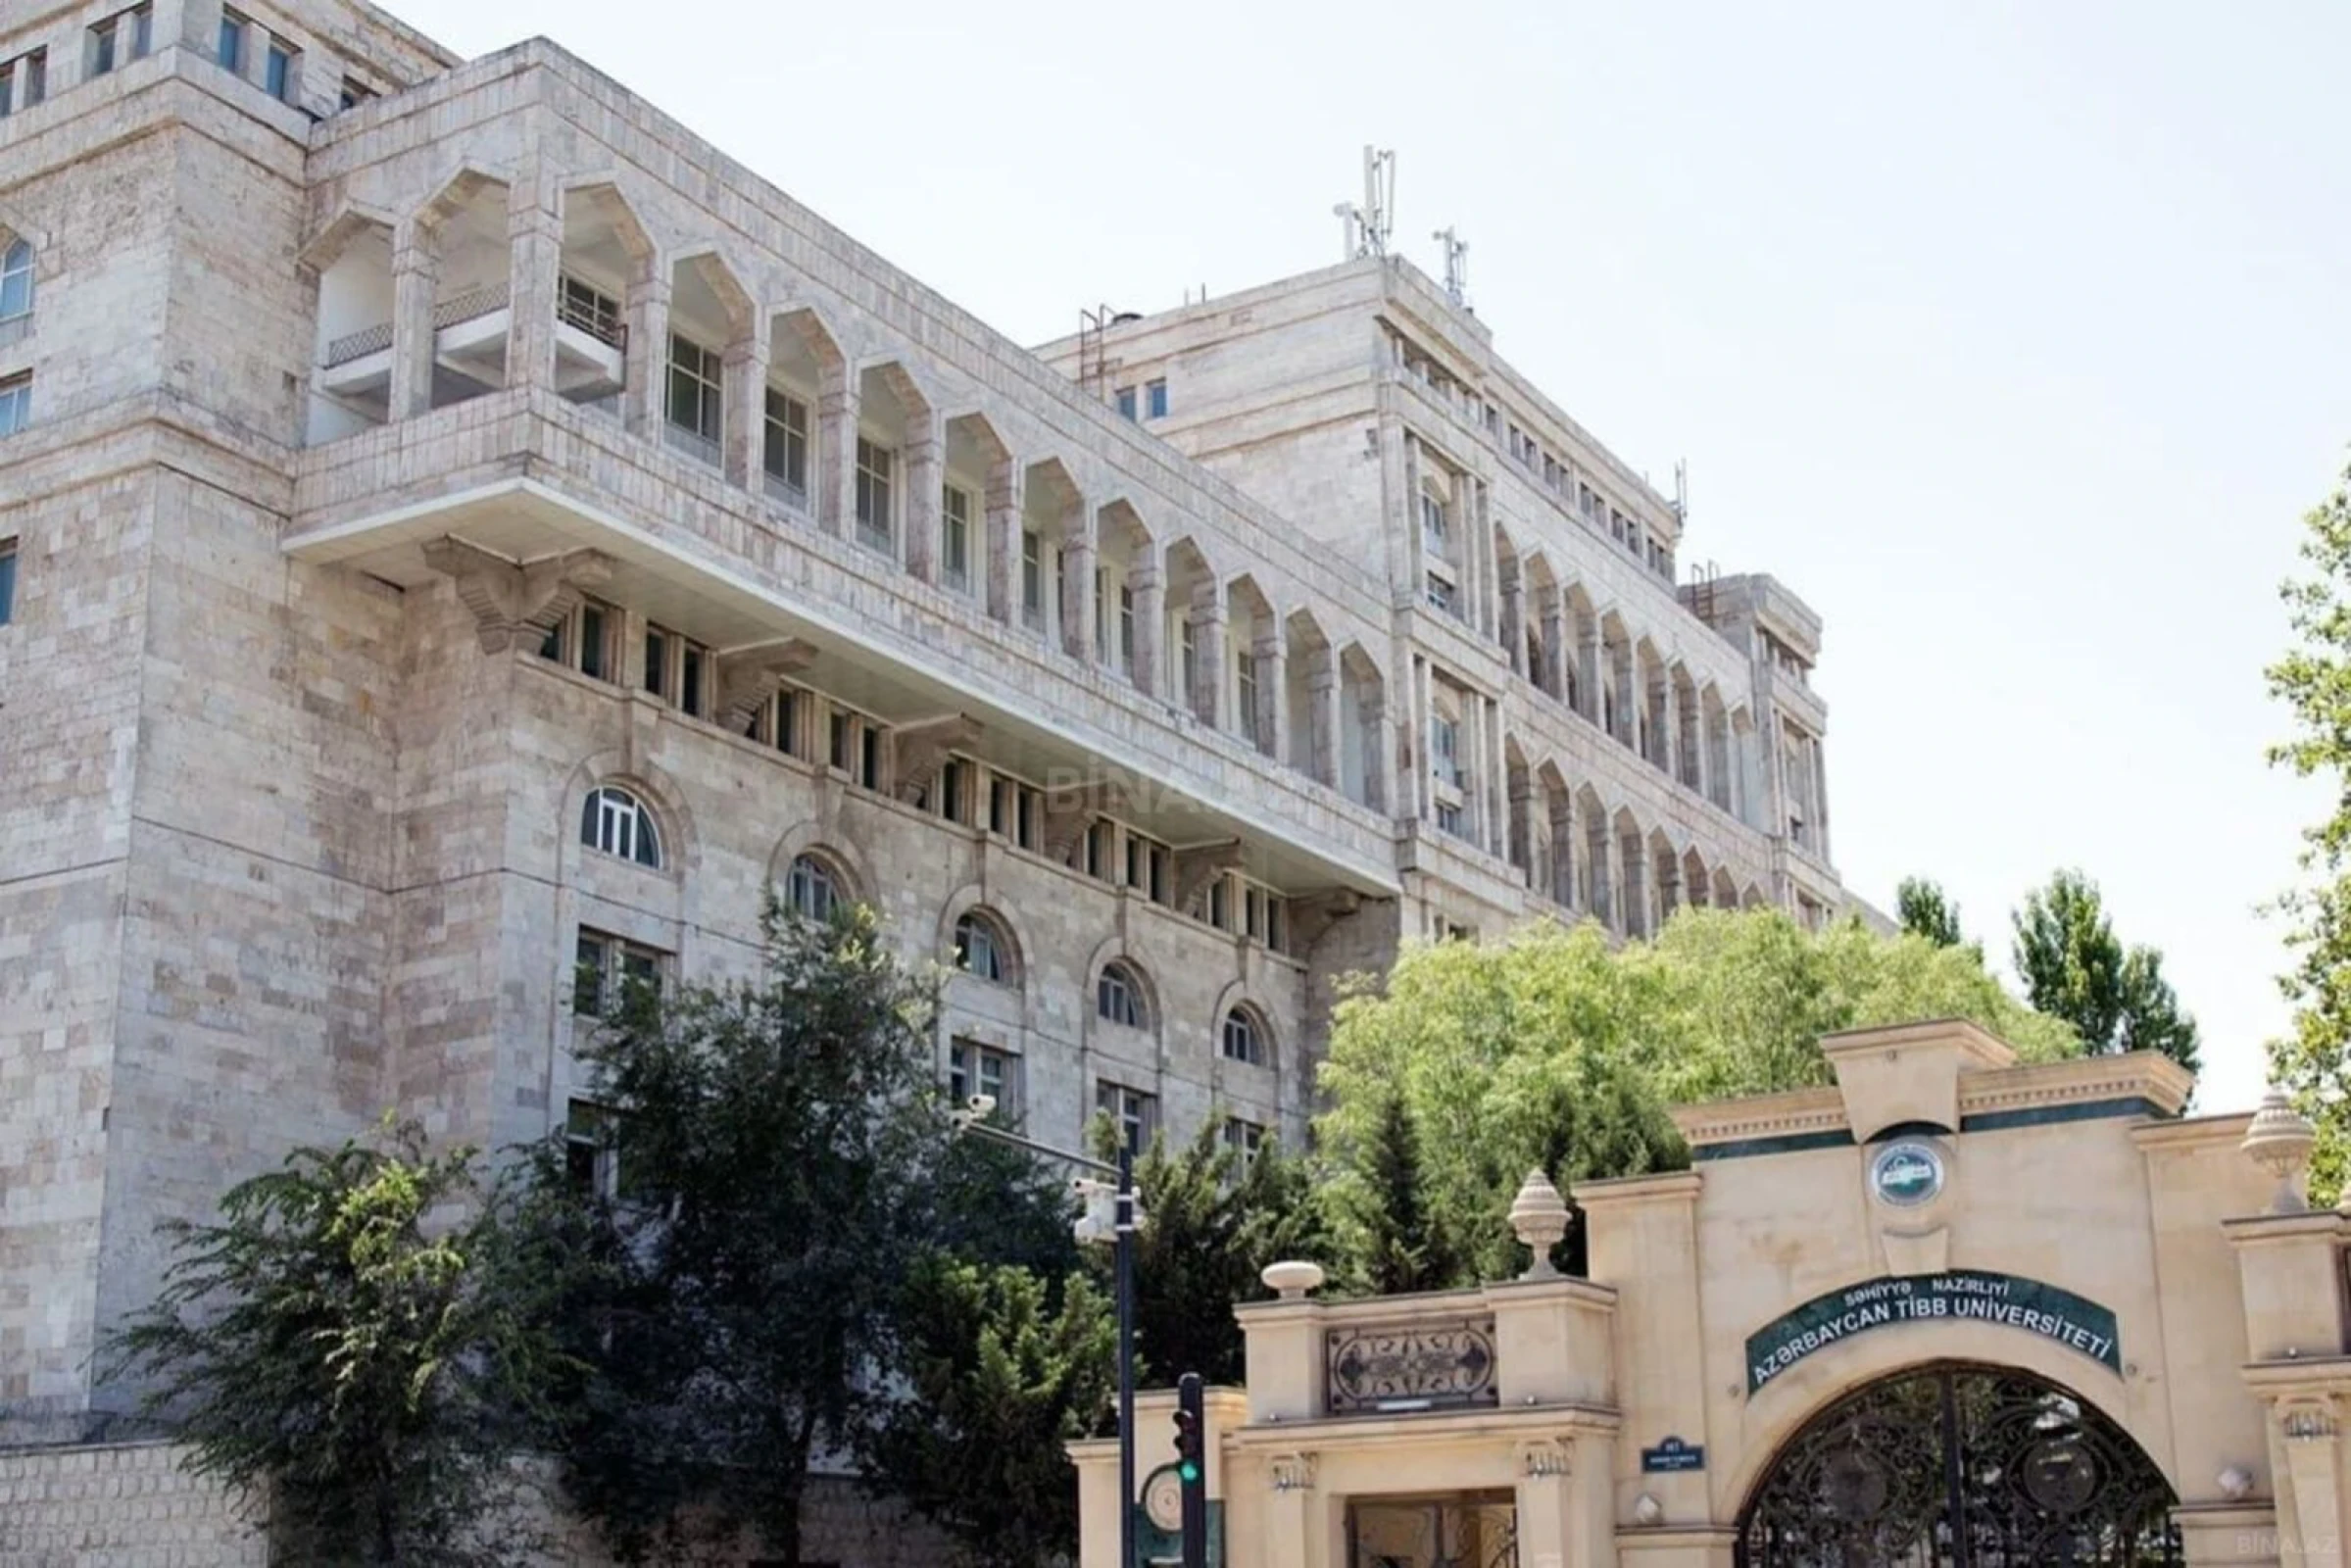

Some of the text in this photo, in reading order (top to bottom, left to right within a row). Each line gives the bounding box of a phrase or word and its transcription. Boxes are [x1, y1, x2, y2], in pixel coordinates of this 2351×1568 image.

[1753, 1295, 2113, 1384] AZƏRBAYCAN TİBB UNİVERSİTETİ
